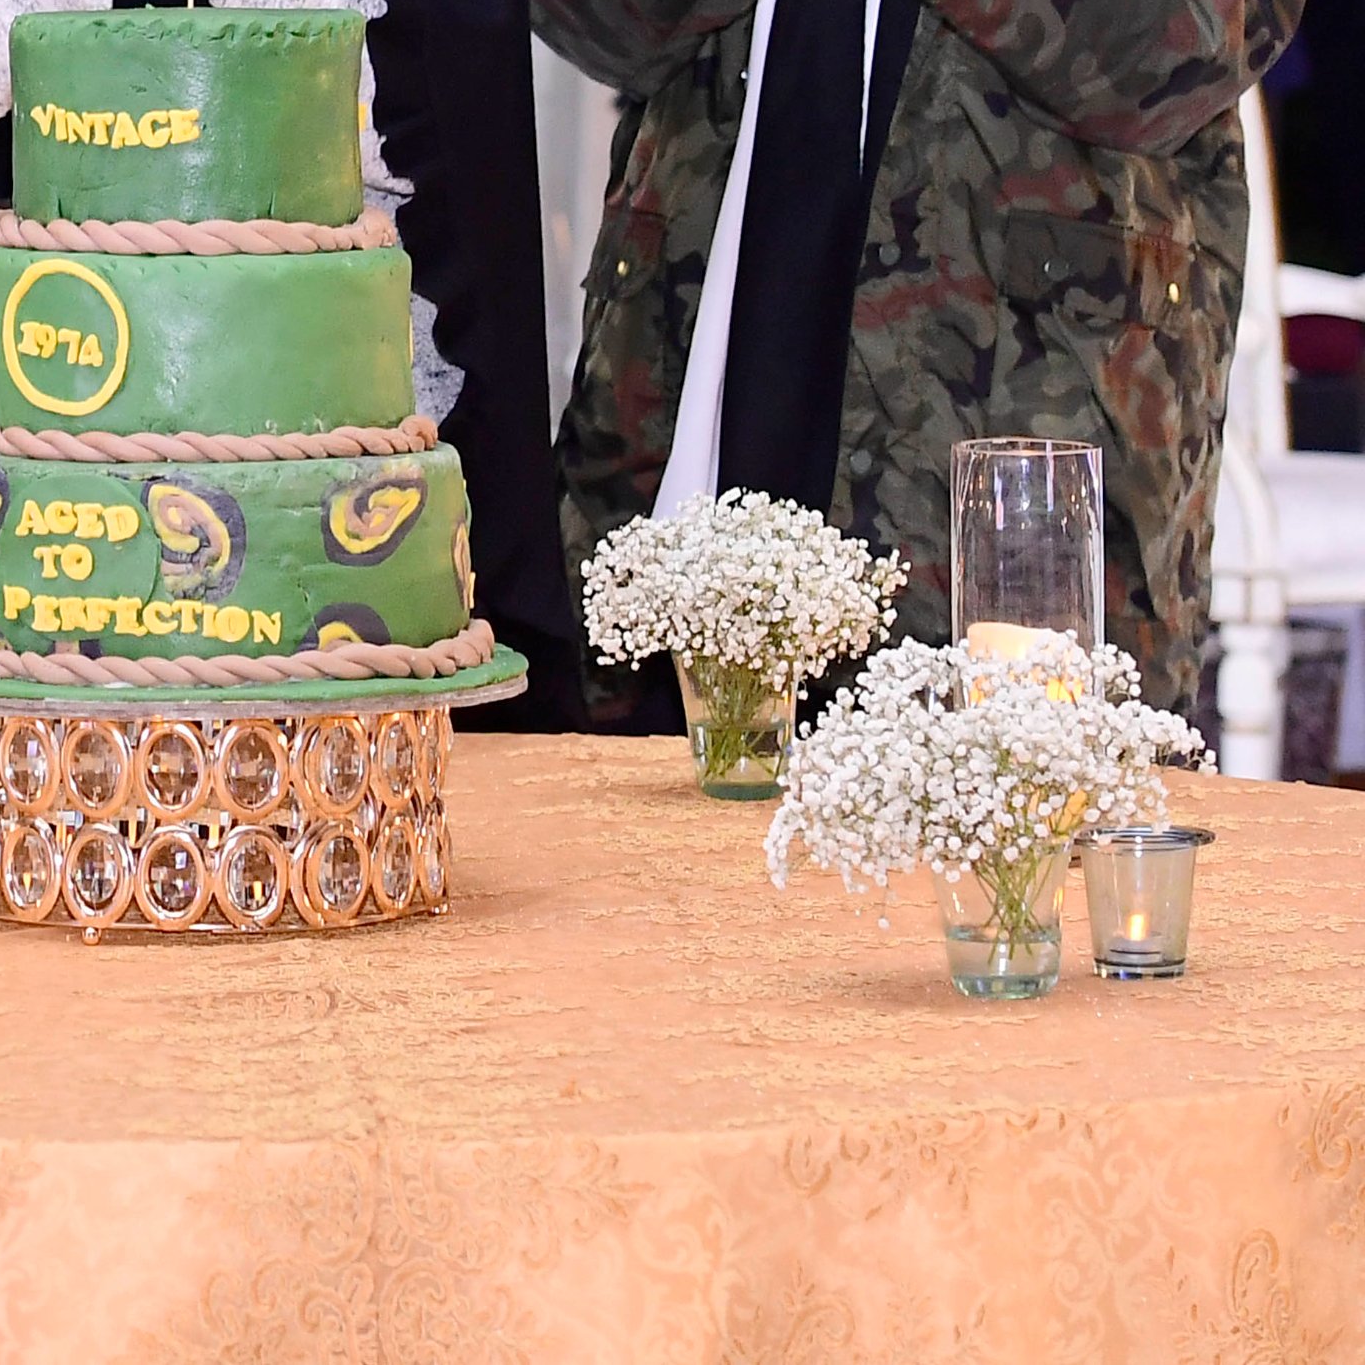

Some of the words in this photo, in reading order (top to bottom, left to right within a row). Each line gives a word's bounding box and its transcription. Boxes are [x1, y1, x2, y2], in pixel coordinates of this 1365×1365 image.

[30, 103, 200, 149] VINTAGE
[17, 321, 103, 367] 1974
[15, 499, 139, 542] AGED
[33, 543, 94, 581] TO
[3, 584, 282, 644] PERFECTION
